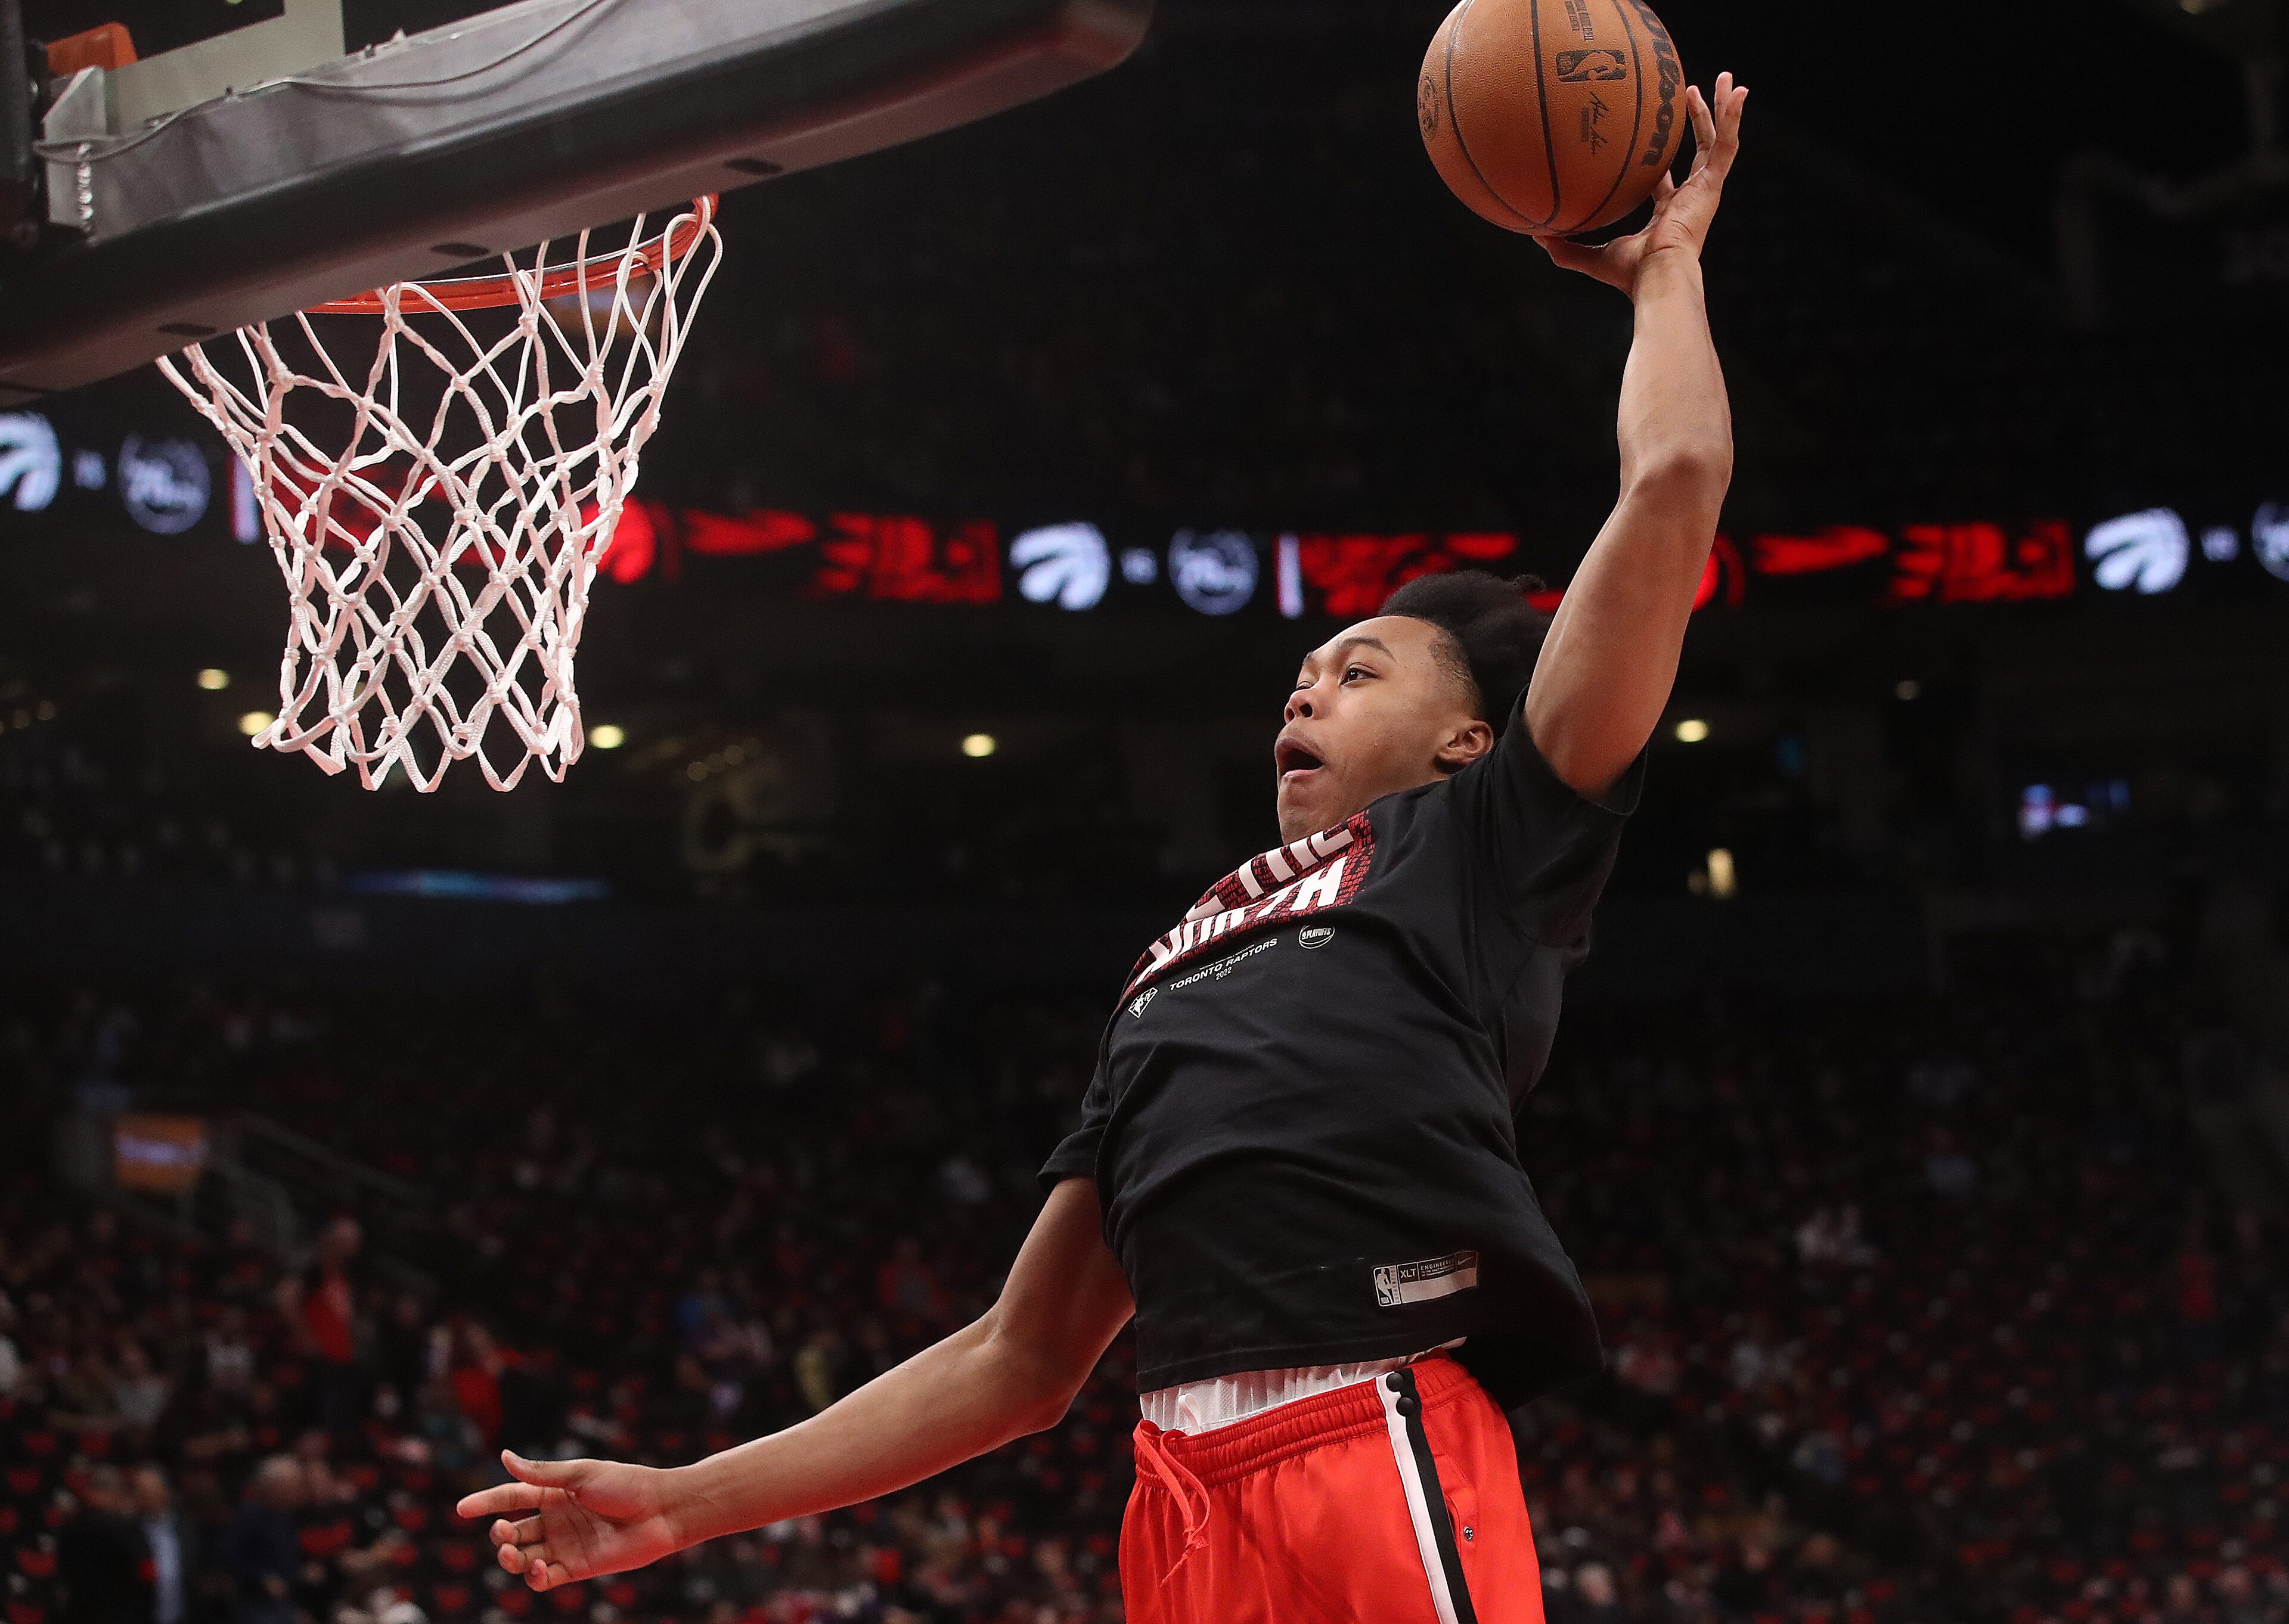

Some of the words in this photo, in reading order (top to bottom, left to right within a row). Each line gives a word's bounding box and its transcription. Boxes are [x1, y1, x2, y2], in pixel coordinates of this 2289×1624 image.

[1169, 964, 1223, 991] TORONTO
[1226, 938, 1278, 967] RAPTORS
[1215, 966, 1232, 981] 2022
[1401, 1268, 1416, 1279] XLT
